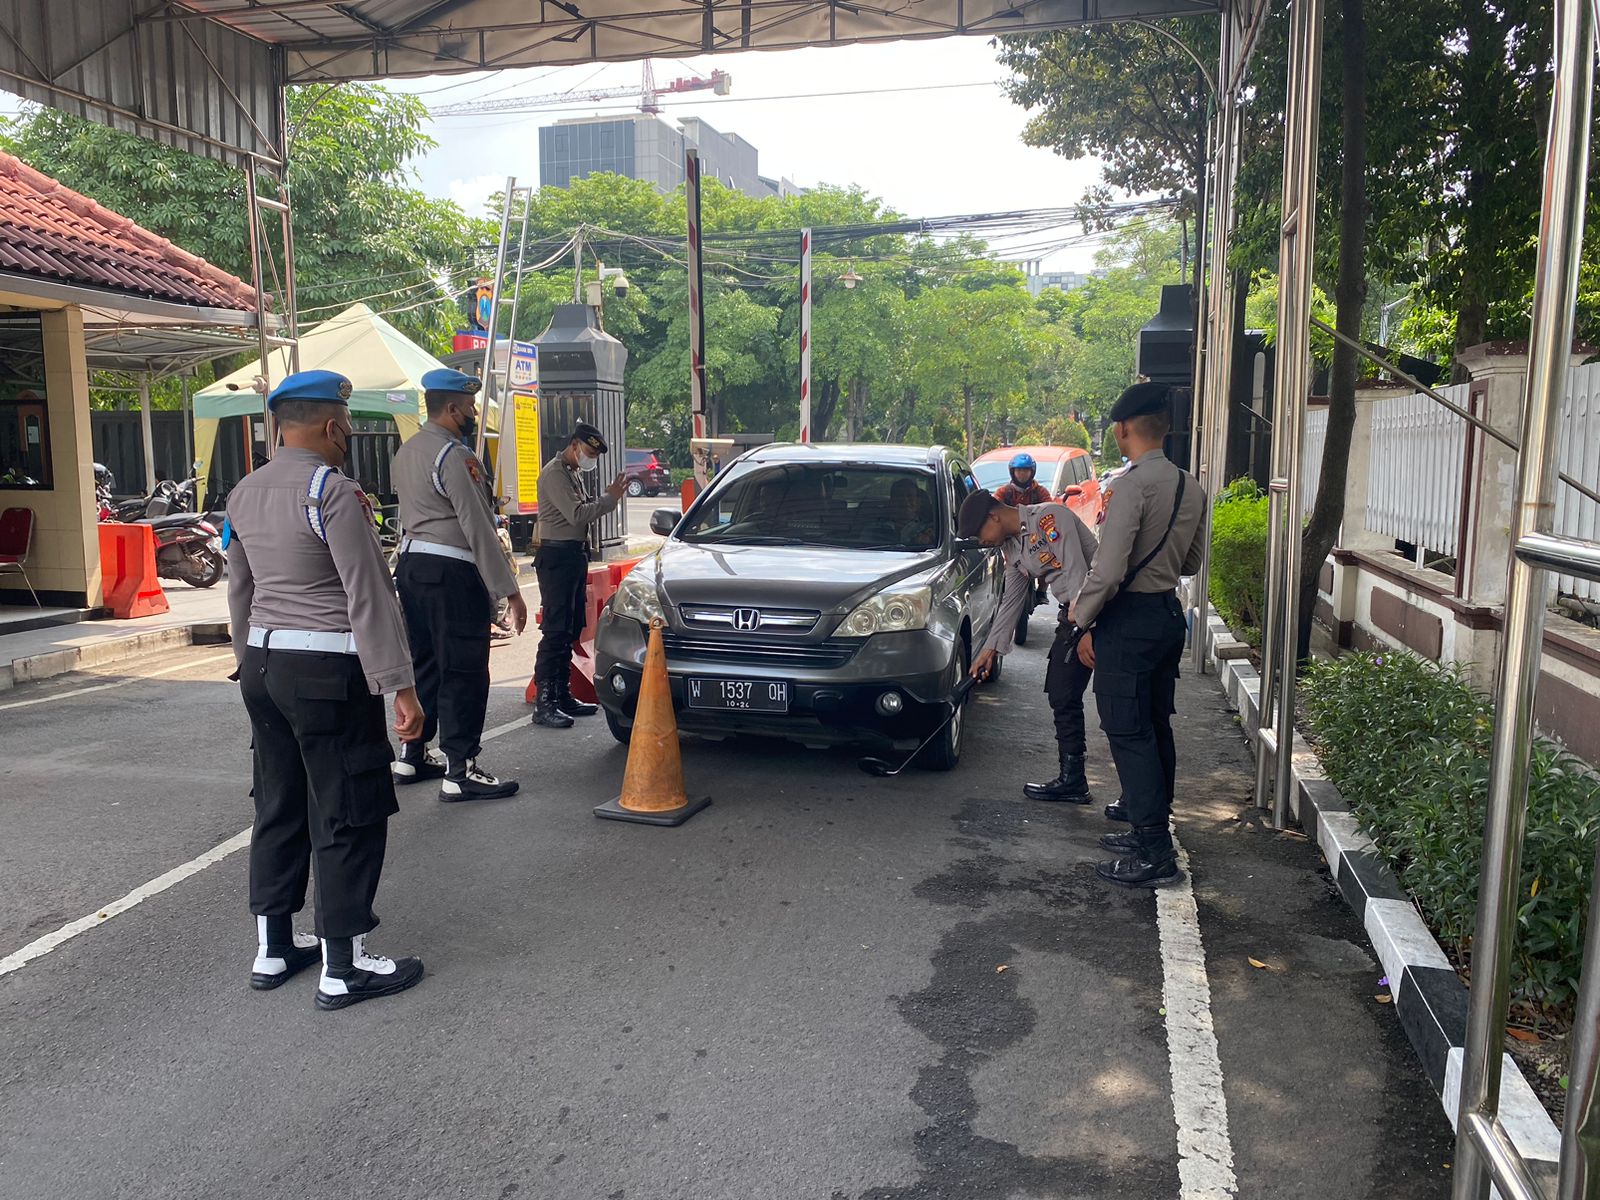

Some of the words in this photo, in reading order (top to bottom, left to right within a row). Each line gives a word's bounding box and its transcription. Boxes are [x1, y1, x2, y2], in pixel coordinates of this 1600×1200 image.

[515, 360, 532, 372] ATM
[691, 680, 701, 698] W
[720, 681, 753, 700] 1537
[768, 683, 786, 702] QH
